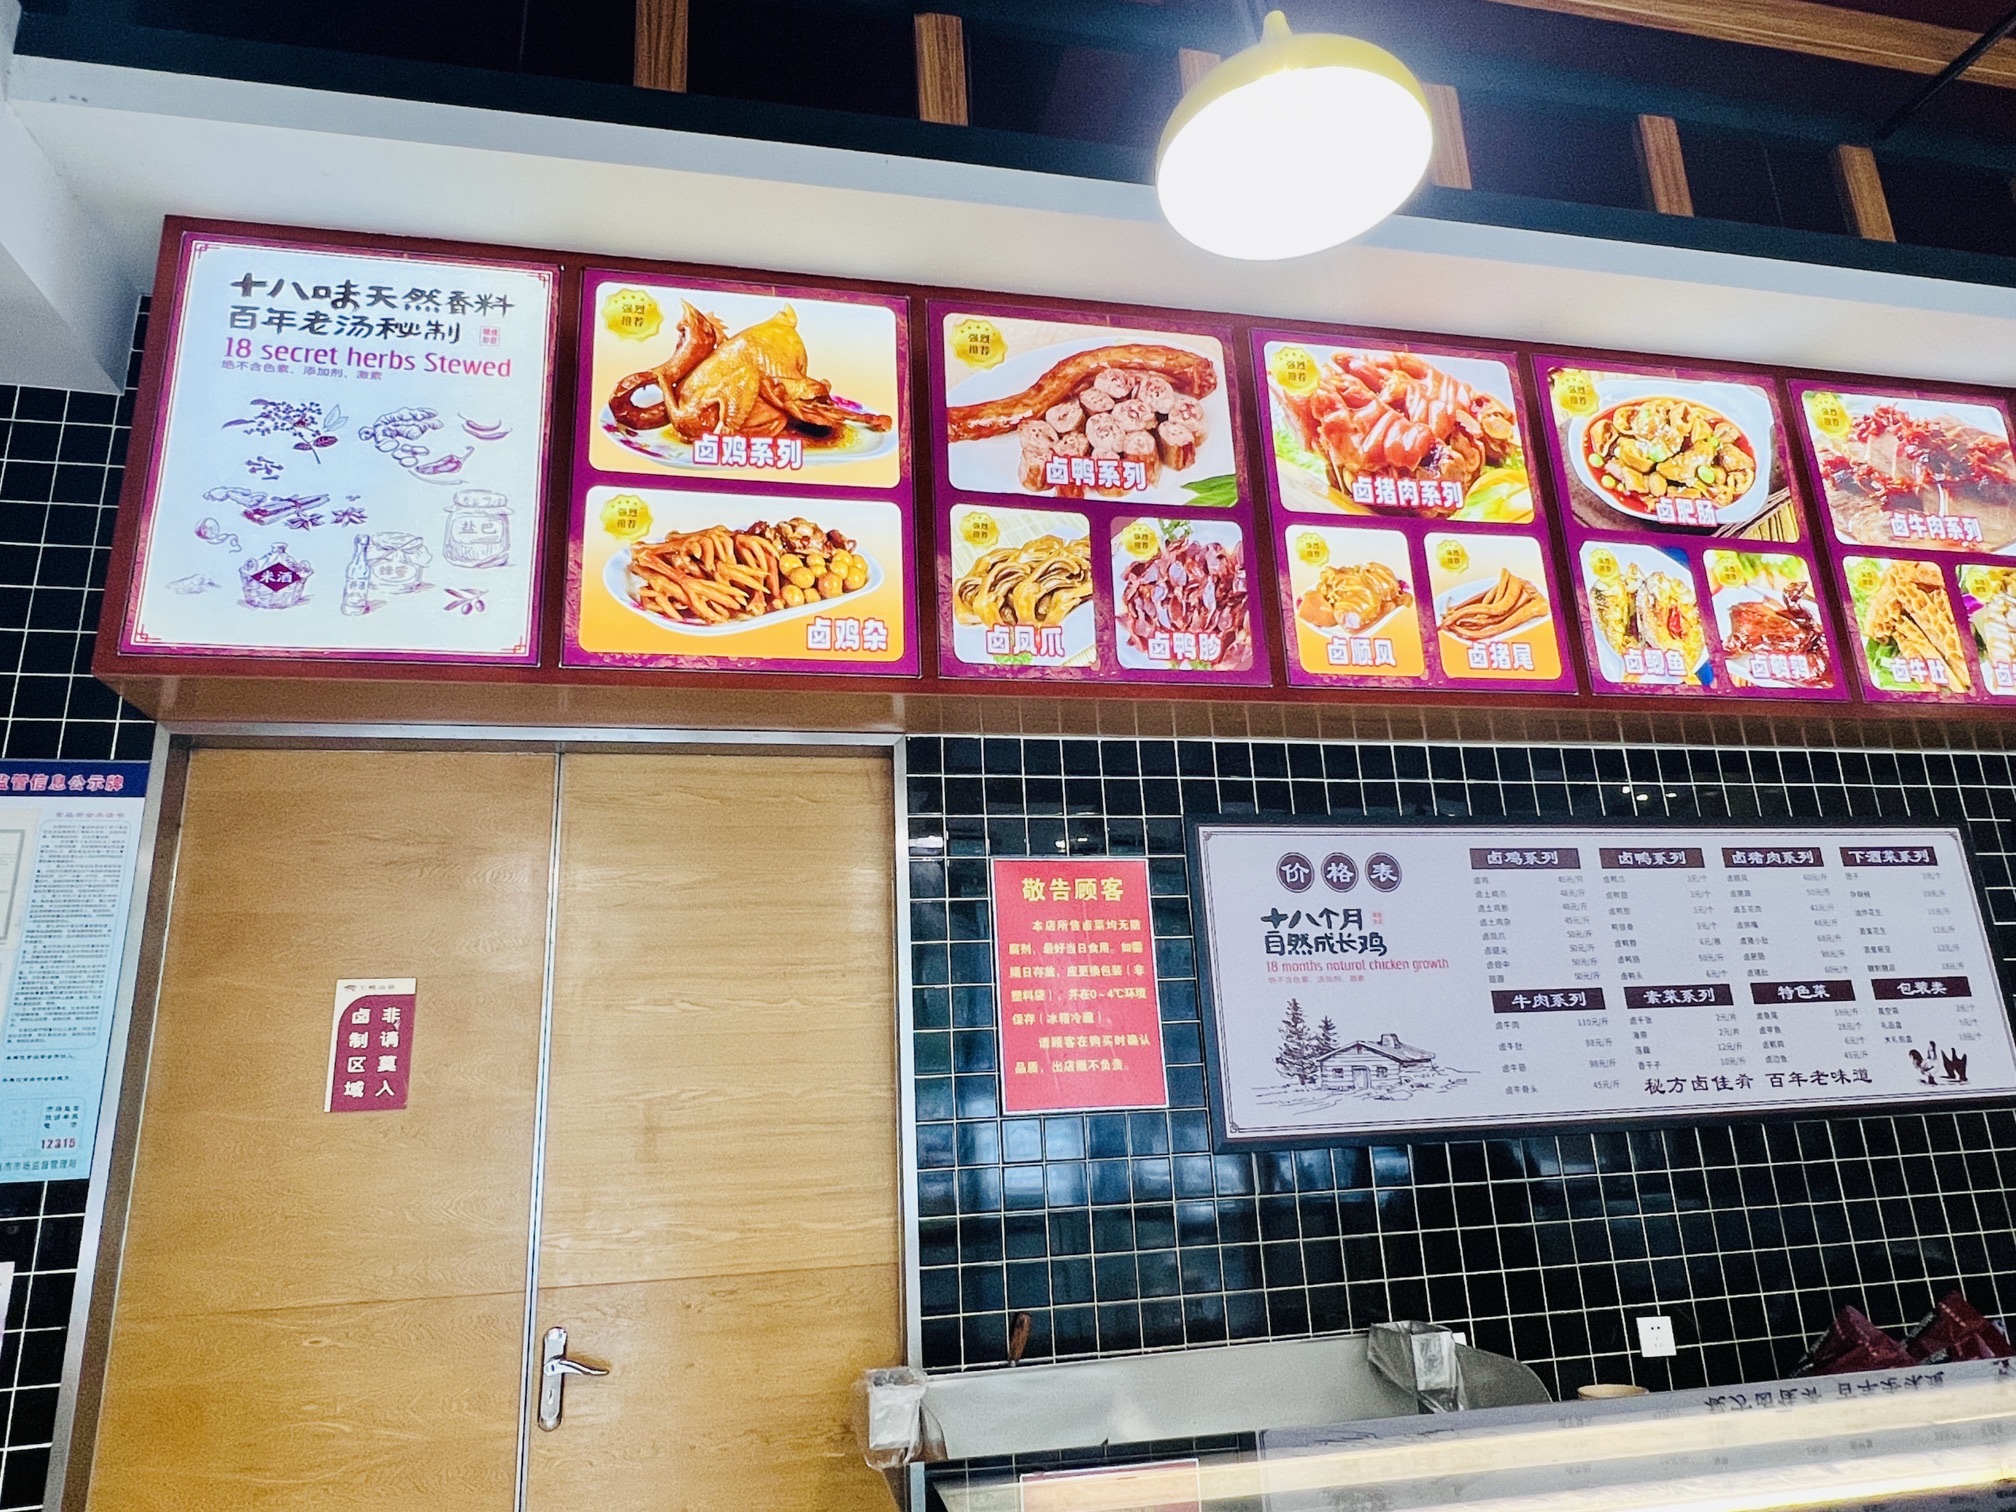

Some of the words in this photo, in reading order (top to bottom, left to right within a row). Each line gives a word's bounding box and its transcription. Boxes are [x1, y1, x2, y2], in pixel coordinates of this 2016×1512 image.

[230, 271, 515, 318] 十八味天然香料
[621, 303, 645, 315] 强烈
[229, 304, 461, 344] 百年老汤秘制
[621, 315, 645, 328] 推荐
[969, 333, 990, 344] 强烈
[224, 336, 251, 359] 18
[261, 343, 338, 366] secret
[347, 346, 416, 371] herbs
[424, 351, 511, 378] Stewed
[969, 345, 990, 356] 推荐
[693, 432, 803, 471] 卤鸡系列
[1045, 454, 1147, 491] 卤鸭系列
[1351, 475, 1464, 508] 卤猪肉系列
[1655, 496, 1718, 527] 卤肥肠
[458, 520, 497, 535] 盐巴
[1889, 510, 1984, 542] 卤牛肉系列
[259, 570, 293, 584] 米酒
[806, 615, 889, 653] 卤鸡杂
[985, 624, 1065, 658] 卤凤爪
[1147, 631, 1222, 661] 卤鸭胗
[1326, 636, 1397, 667] 卤顺风
[1467, 641, 1535, 671] 卤猪尾
[1890, 656, 1950, 687] 卤牛肚
[1994, 661, 2016, 688] 卤
[1487, 851, 1559, 866] 卤鸡系列
[1618, 850, 1687, 866] 卤鸭系列
[1731, 850, 1814, 865] 卤猪肉系列
[1847, 849, 1930, 864] 下酒菜系列
[1281, 861, 1398, 884] 价格表
[1021, 876, 1124, 902] 敬告顾客
[1031, 918, 1142, 932] 本店所售卤菜均无防
[1260, 906, 1363, 931] 十八个月
[1567, 929, 1592, 938] 50元/斤
[1264, 930, 1388, 957] 自然成长鸡
[1569, 943, 1595, 952] 50元/斤
[1266, 960, 1279, 973] 18
[1282, 960, 1323, 973] months
[1326, 959, 1366, 971] natural
[1369, 958, 1410, 971] chicken
[1412, 958, 1450, 973] growth
[1571, 957, 1597, 966] 50元/斤
[1574, 972, 1600, 982] 50元/斤
[1642, 986, 1716, 1005] 素菜系列
[1777, 984, 1831, 1000] 特色菜
[1896, 980, 1949, 996] 包装类
[1511, 990, 1587, 1010] 牛肉系列
[1577, 1017, 1609, 1027] 110元/斤
[343, 1007, 371, 1098] 卤制区域
[374, 1006, 402, 1097] 非请莫入
[1717, 1041, 1743, 1052] 12元/斤
[1593, 1079, 1620, 1090] 45元/斤
[1644, 1073, 1754, 1096] 秘方卤佳肴
[1764, 1067, 1873, 1088] 百年老味道
[41, 1137, 76, 1150] 12315
[0, 1159, 77, 1171] 市市场监督管理局
